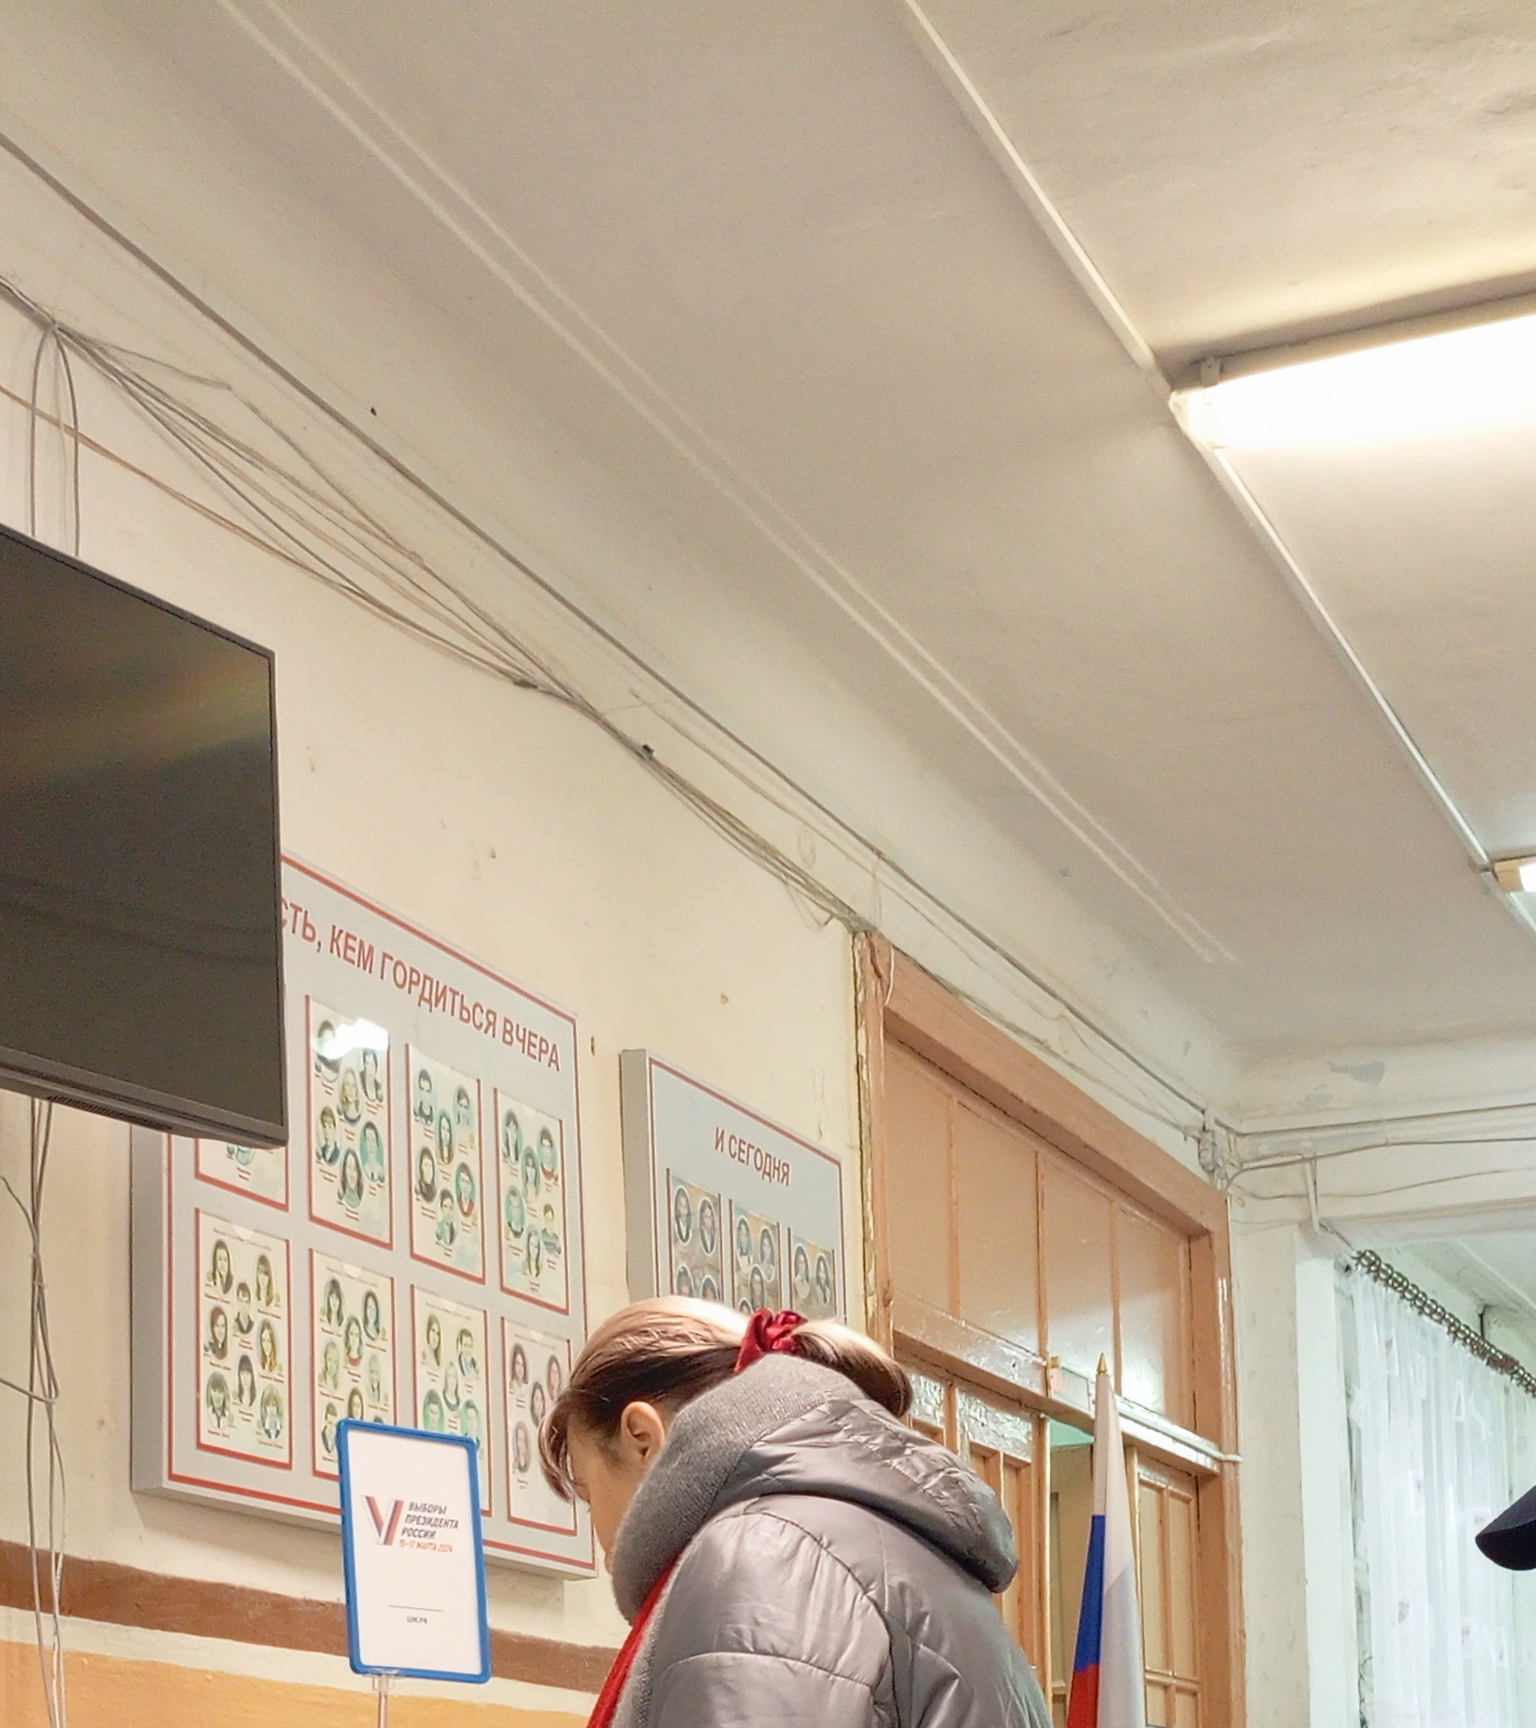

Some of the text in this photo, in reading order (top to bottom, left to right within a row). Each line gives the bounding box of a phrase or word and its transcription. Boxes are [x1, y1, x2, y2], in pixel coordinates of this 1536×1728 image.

[329, 924, 374, 975] КЕМ
[380, 951, 497, 1039] ГОРДИТЬСЯ
[502, 1017, 560, 1072] ВЧЕРА
[715, 1126, 790, 1187] И СЕГОДНЯ
[408, 1502, 447, 1515] ВЫБОРЫ
[405, 1514, 459, 1529] ПРЕЗИДЕНТА
[401, 1527, 436, 1539] РОССИИ
